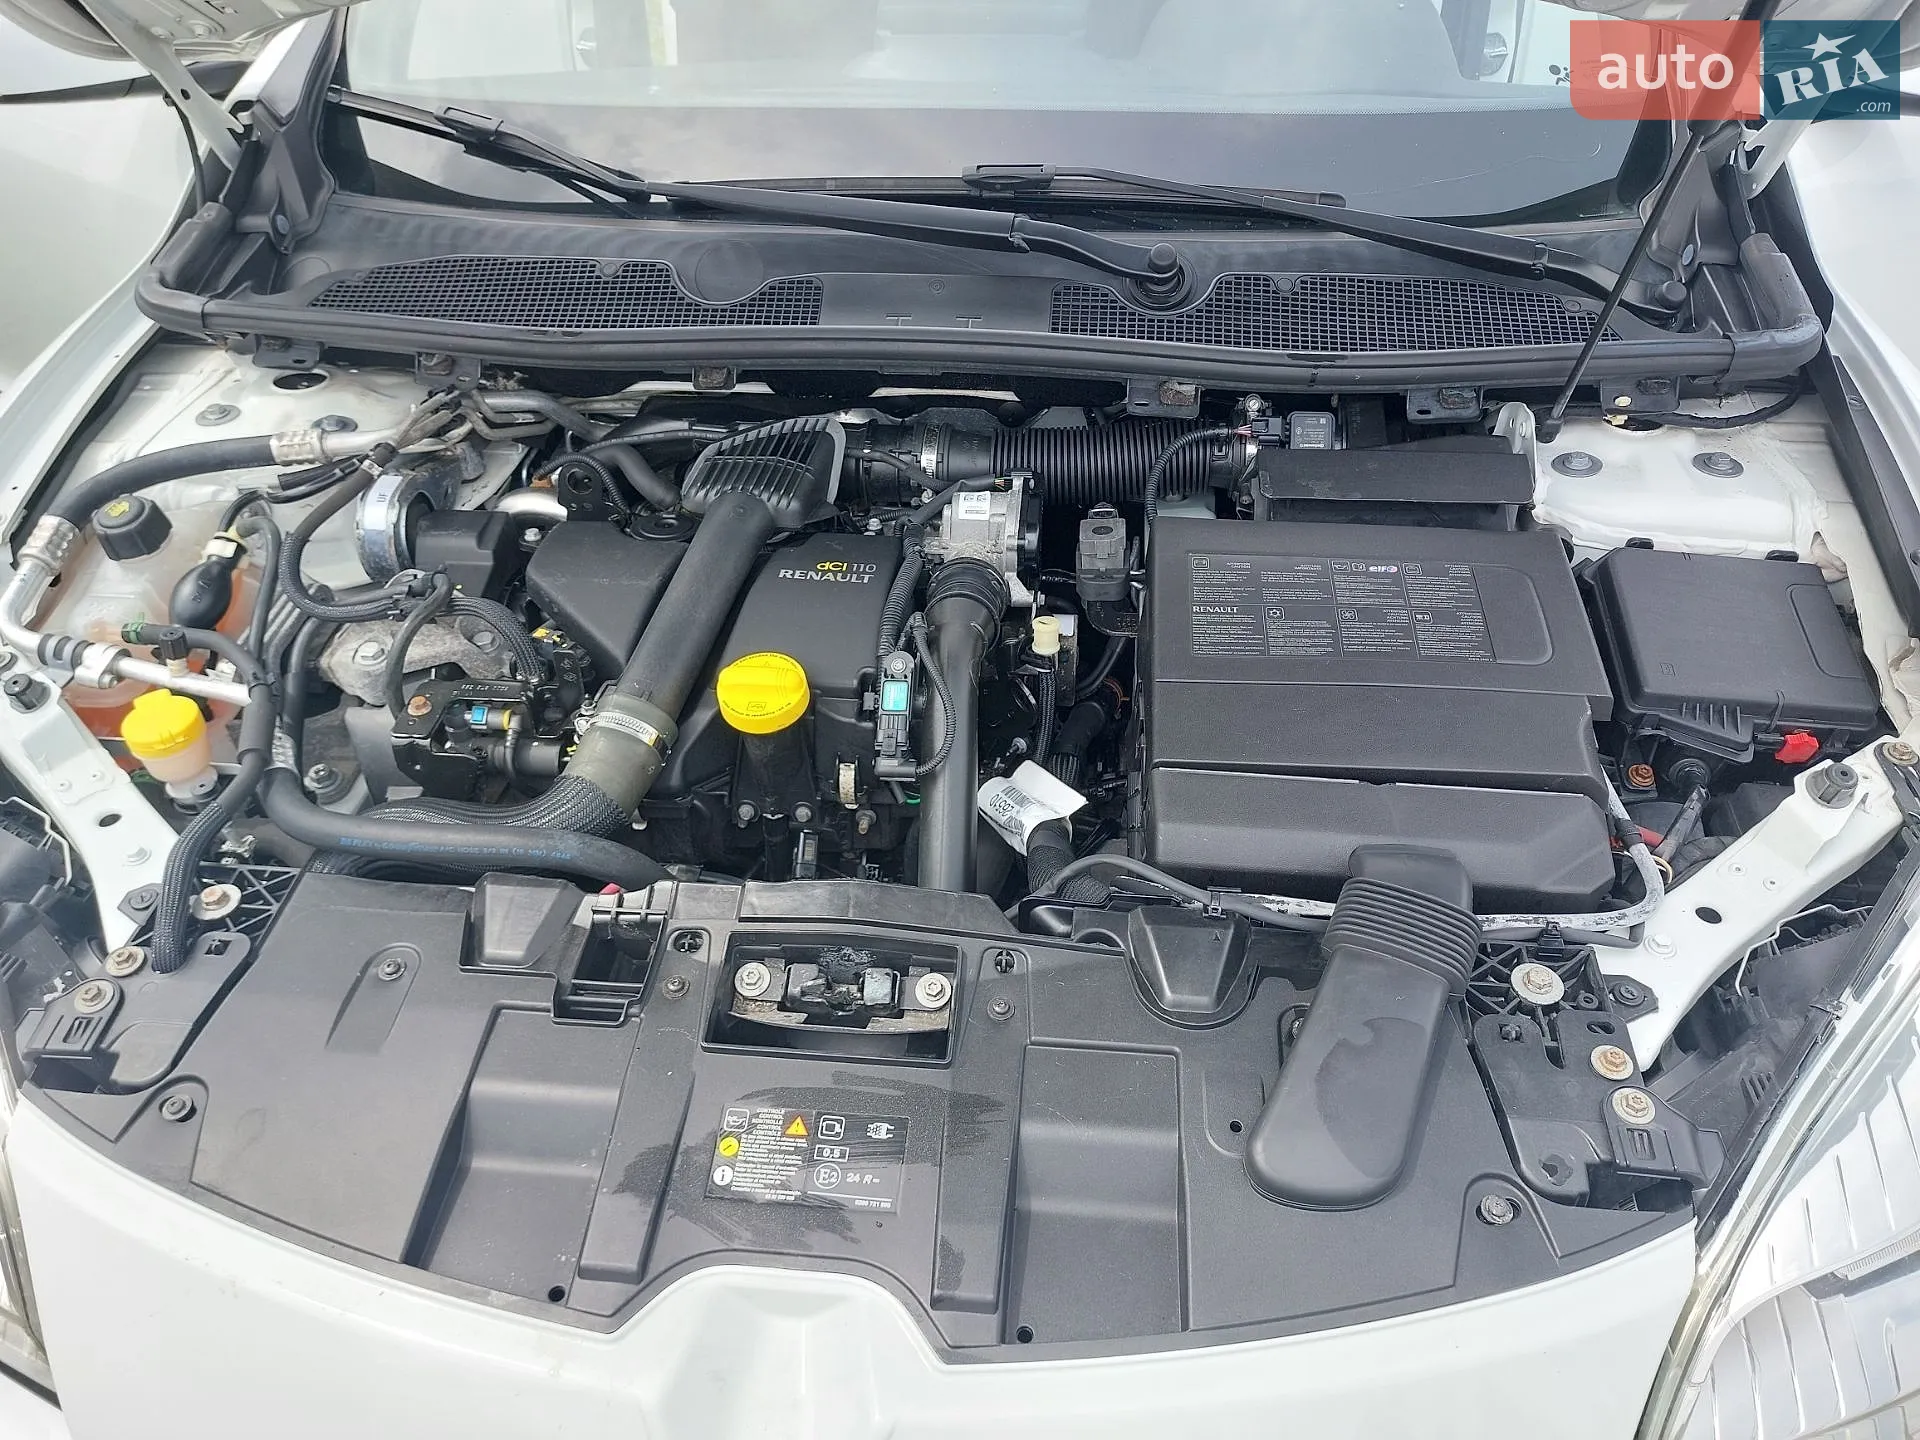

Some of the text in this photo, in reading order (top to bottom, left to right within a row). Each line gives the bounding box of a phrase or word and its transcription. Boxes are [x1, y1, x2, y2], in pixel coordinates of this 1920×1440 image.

[851, 563, 877, 573] 110
[778, 569, 875, 584] RENAULT
[1192, 605, 1239, 613] RENAULT
[846, 1173, 861, 1184] 24
